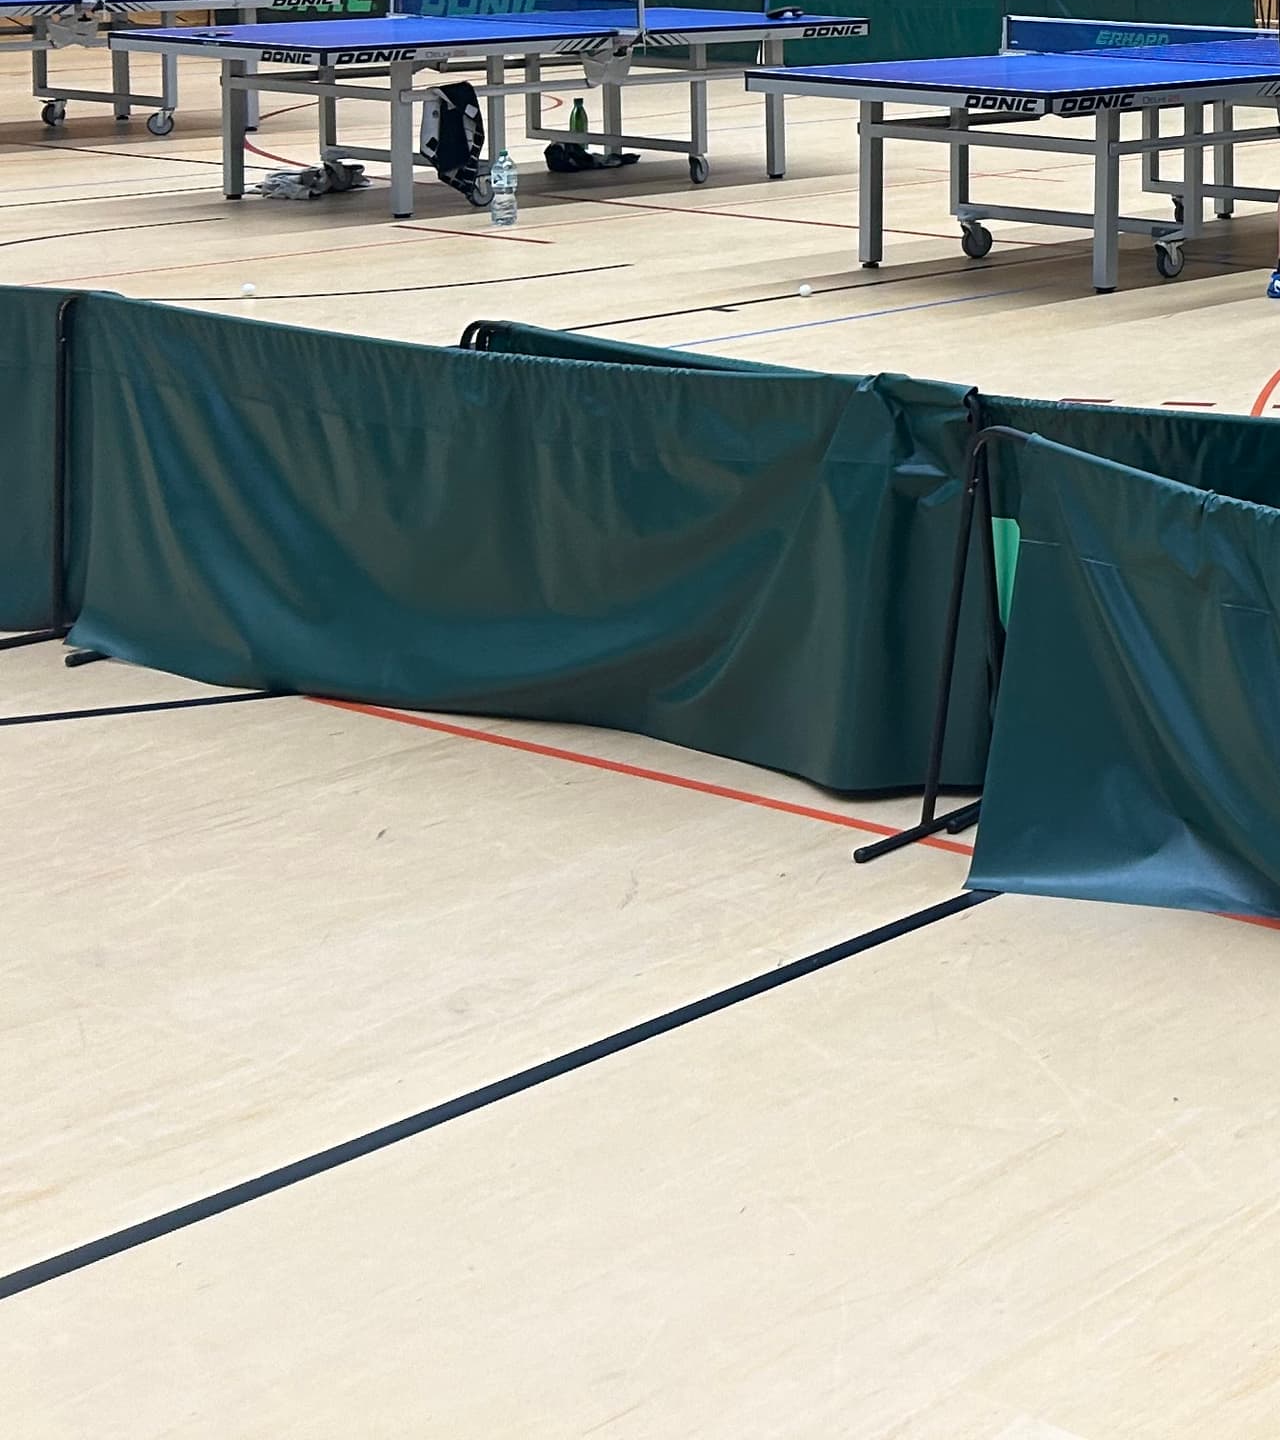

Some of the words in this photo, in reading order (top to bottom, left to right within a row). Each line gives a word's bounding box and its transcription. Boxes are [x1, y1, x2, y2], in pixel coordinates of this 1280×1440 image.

[801, 25, 863, 38] DONIC
[261, 51, 312, 65] DONIC
[336, 49, 417, 65] DONIC
[964, 94, 1039, 112] DONIC
[1060, 94, 1136, 113] DONIC
